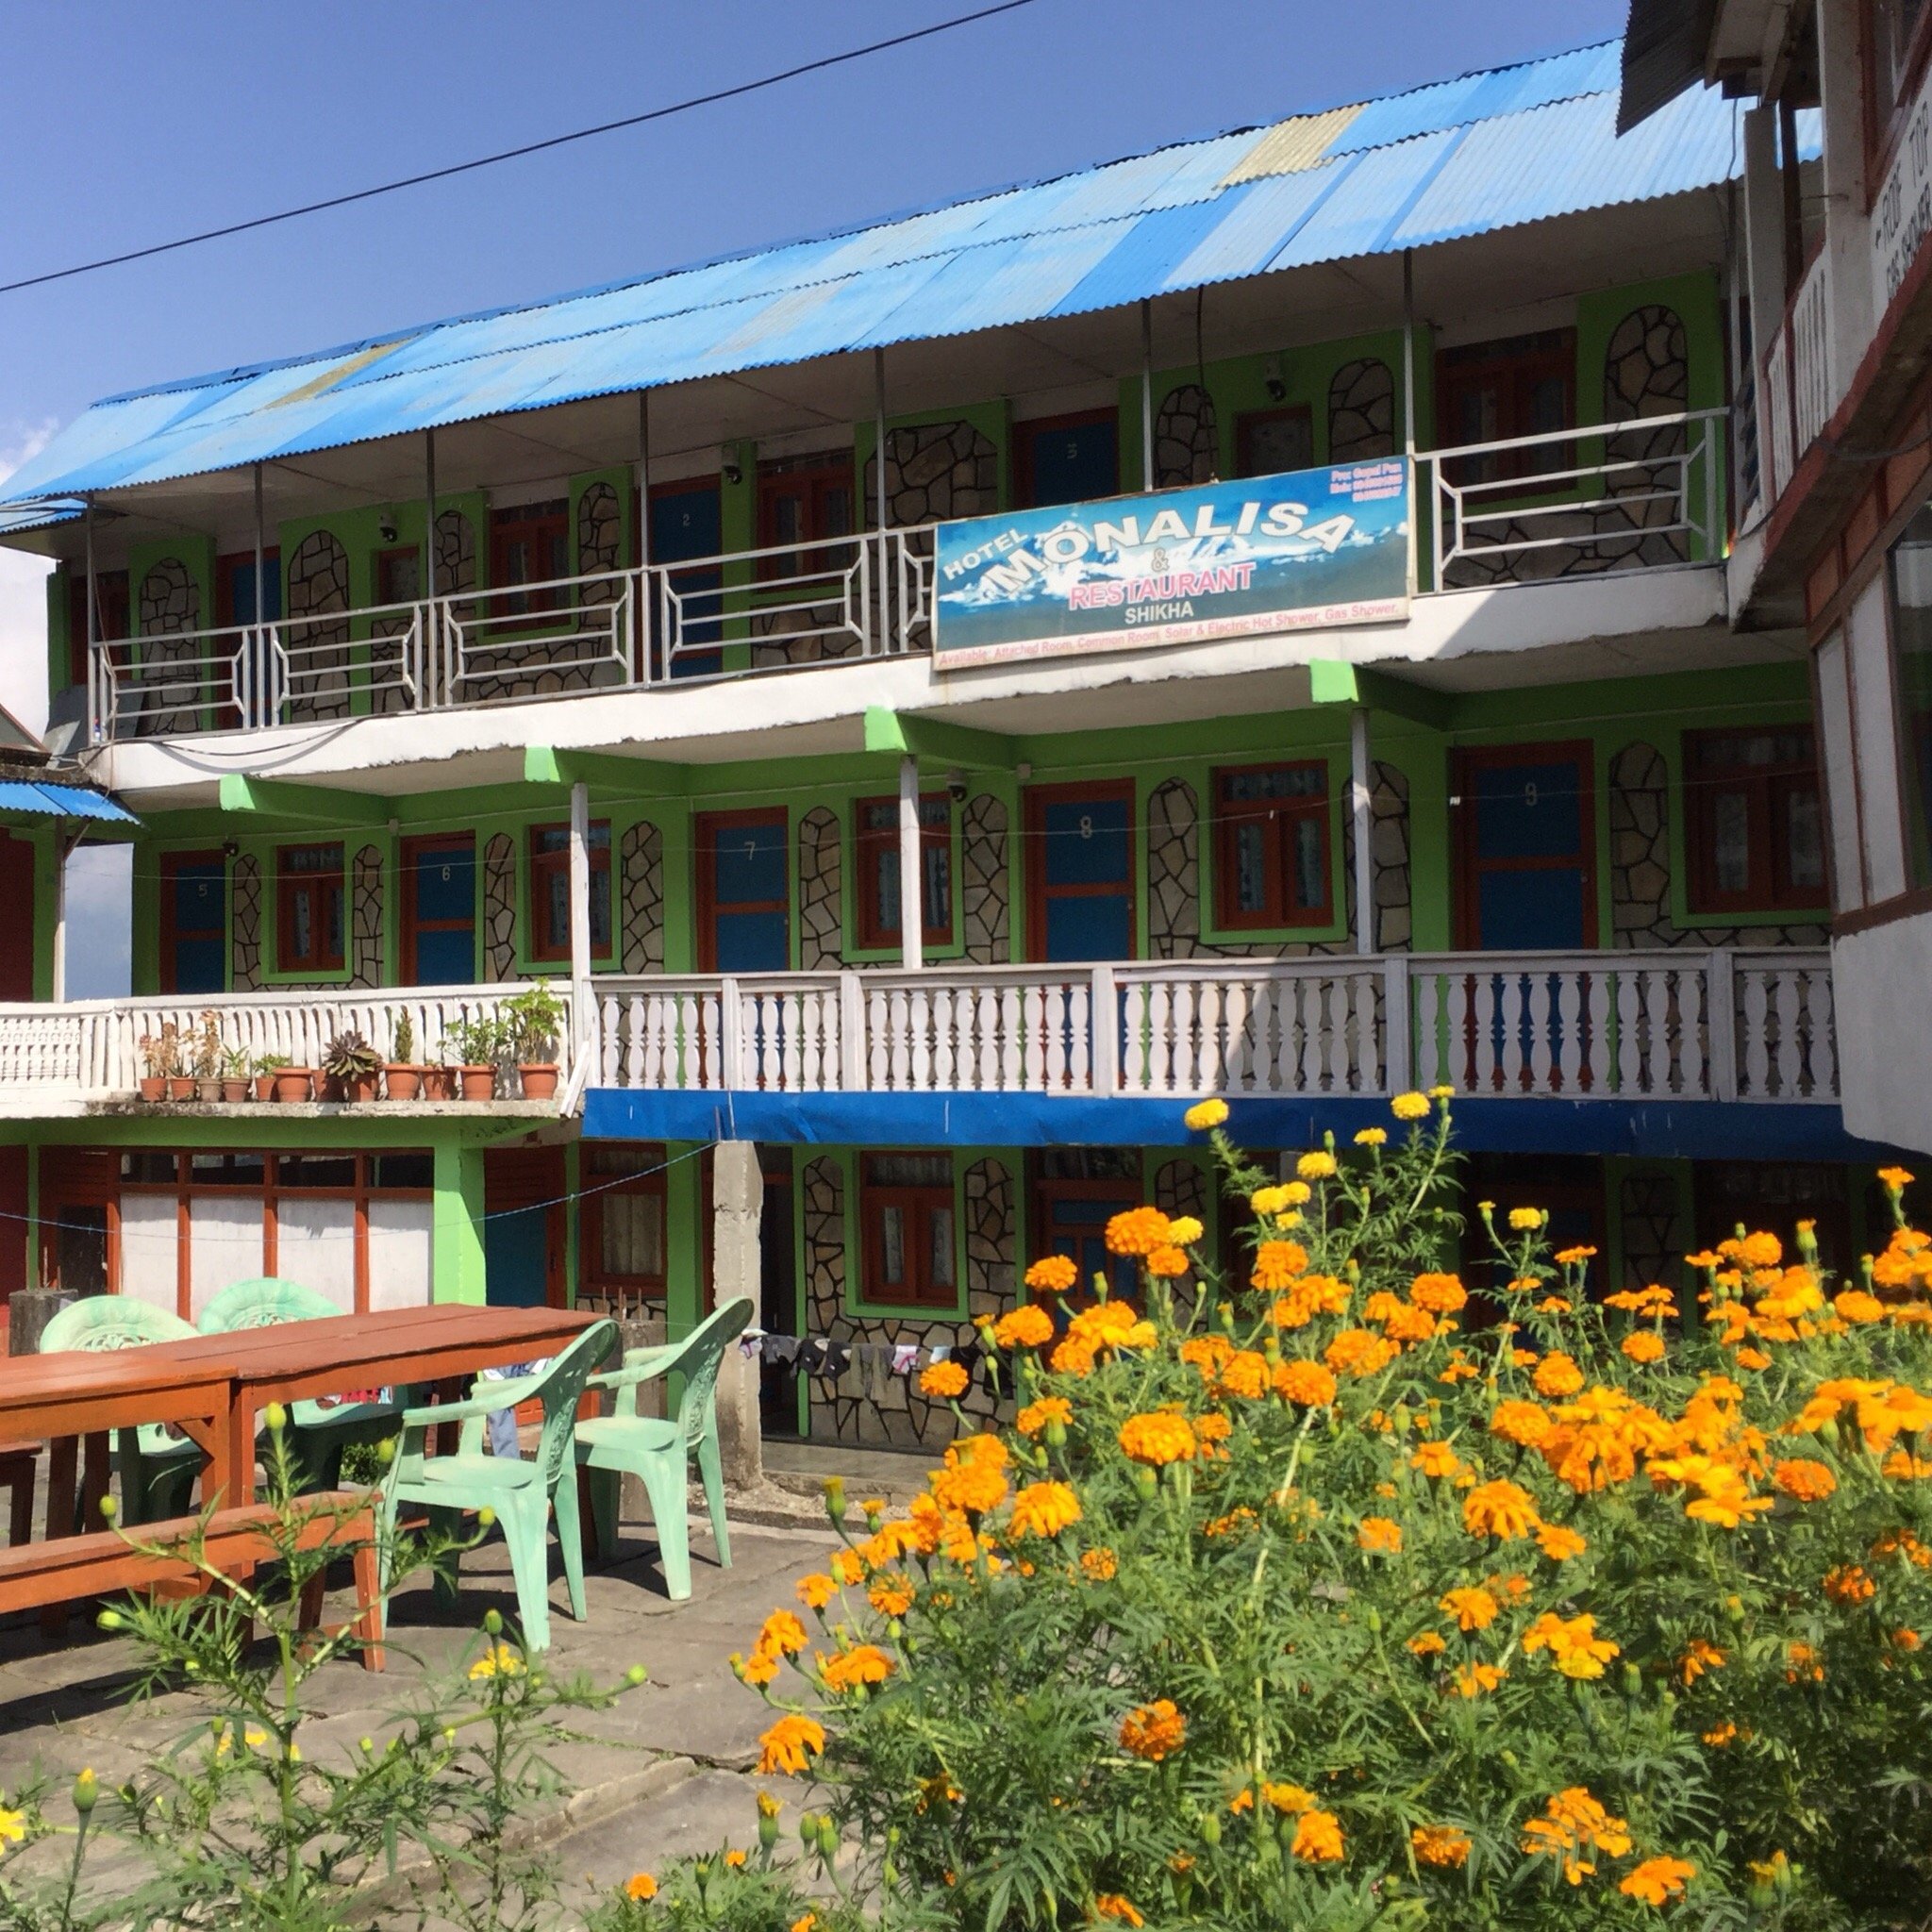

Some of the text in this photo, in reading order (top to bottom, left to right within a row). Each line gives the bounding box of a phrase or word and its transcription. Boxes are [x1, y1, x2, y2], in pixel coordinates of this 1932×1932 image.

[682, 513, 691, 526] 2
[942, 501, 1356, 593] HOTEL MONALISA
[1151, 547, 1170, 573] &
[1069, 561, 1257, 610] RESTAURANT
[1124, 601, 1193, 625] SHIKHA
[1077, 636, 1124, 649] Common
[1165, 625, 1192, 639] Solar
[1195, 624, 1205, 636] &
[1208, 619, 1250, 635] Electric
[1253, 617, 1273, 629] Hot
[1325, 607, 1347, 621] Gas
[1080, 816, 1092, 839] 8
[744, 841, 756, 860] 7
[442, 865, 451, 881] 6
